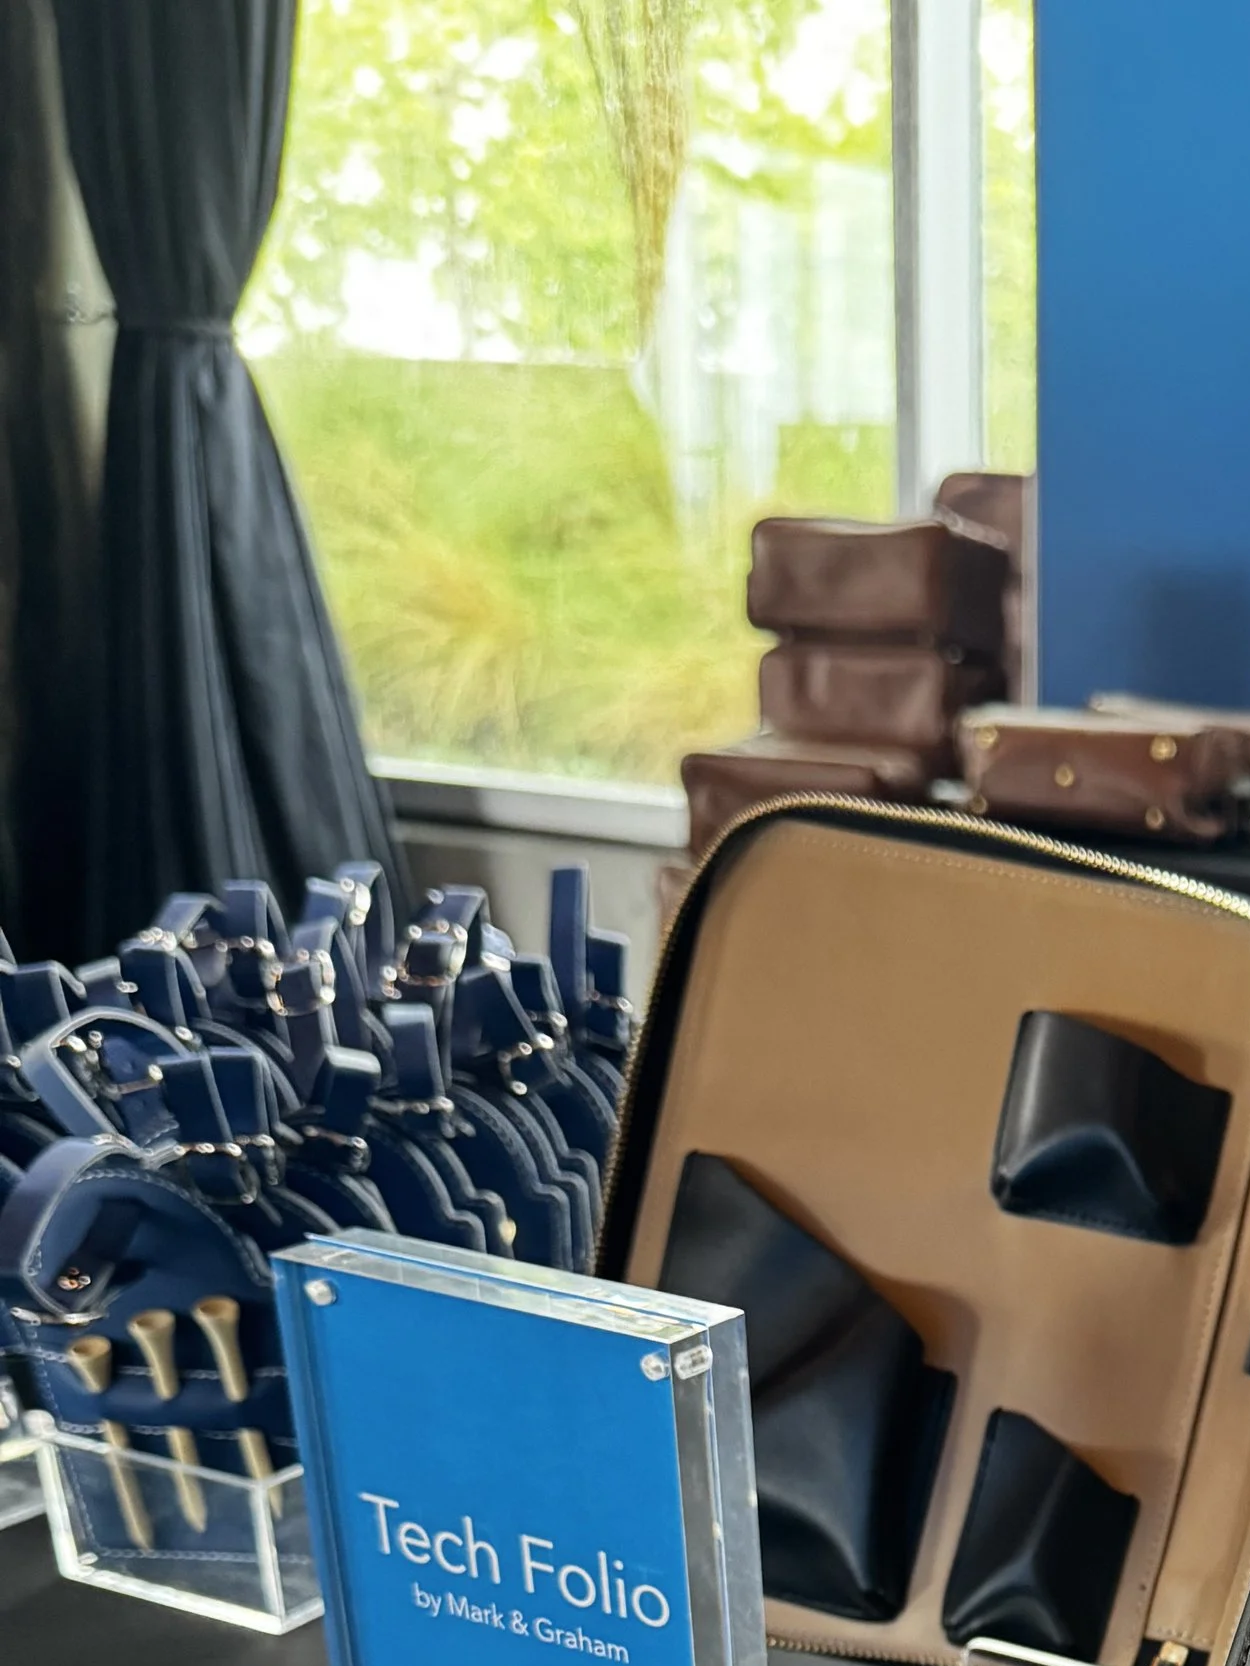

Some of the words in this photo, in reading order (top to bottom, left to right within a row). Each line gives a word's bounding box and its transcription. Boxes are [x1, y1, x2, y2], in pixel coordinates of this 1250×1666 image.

[359, 1492, 501, 1584] Tech
[519, 1534, 671, 1628] Folio
[413, 1582, 441, 1617] by
[447, 1593, 505, 1629] Mark
[509, 1611, 529, 1637] &
[533, 1617, 630, 1664] Graham
